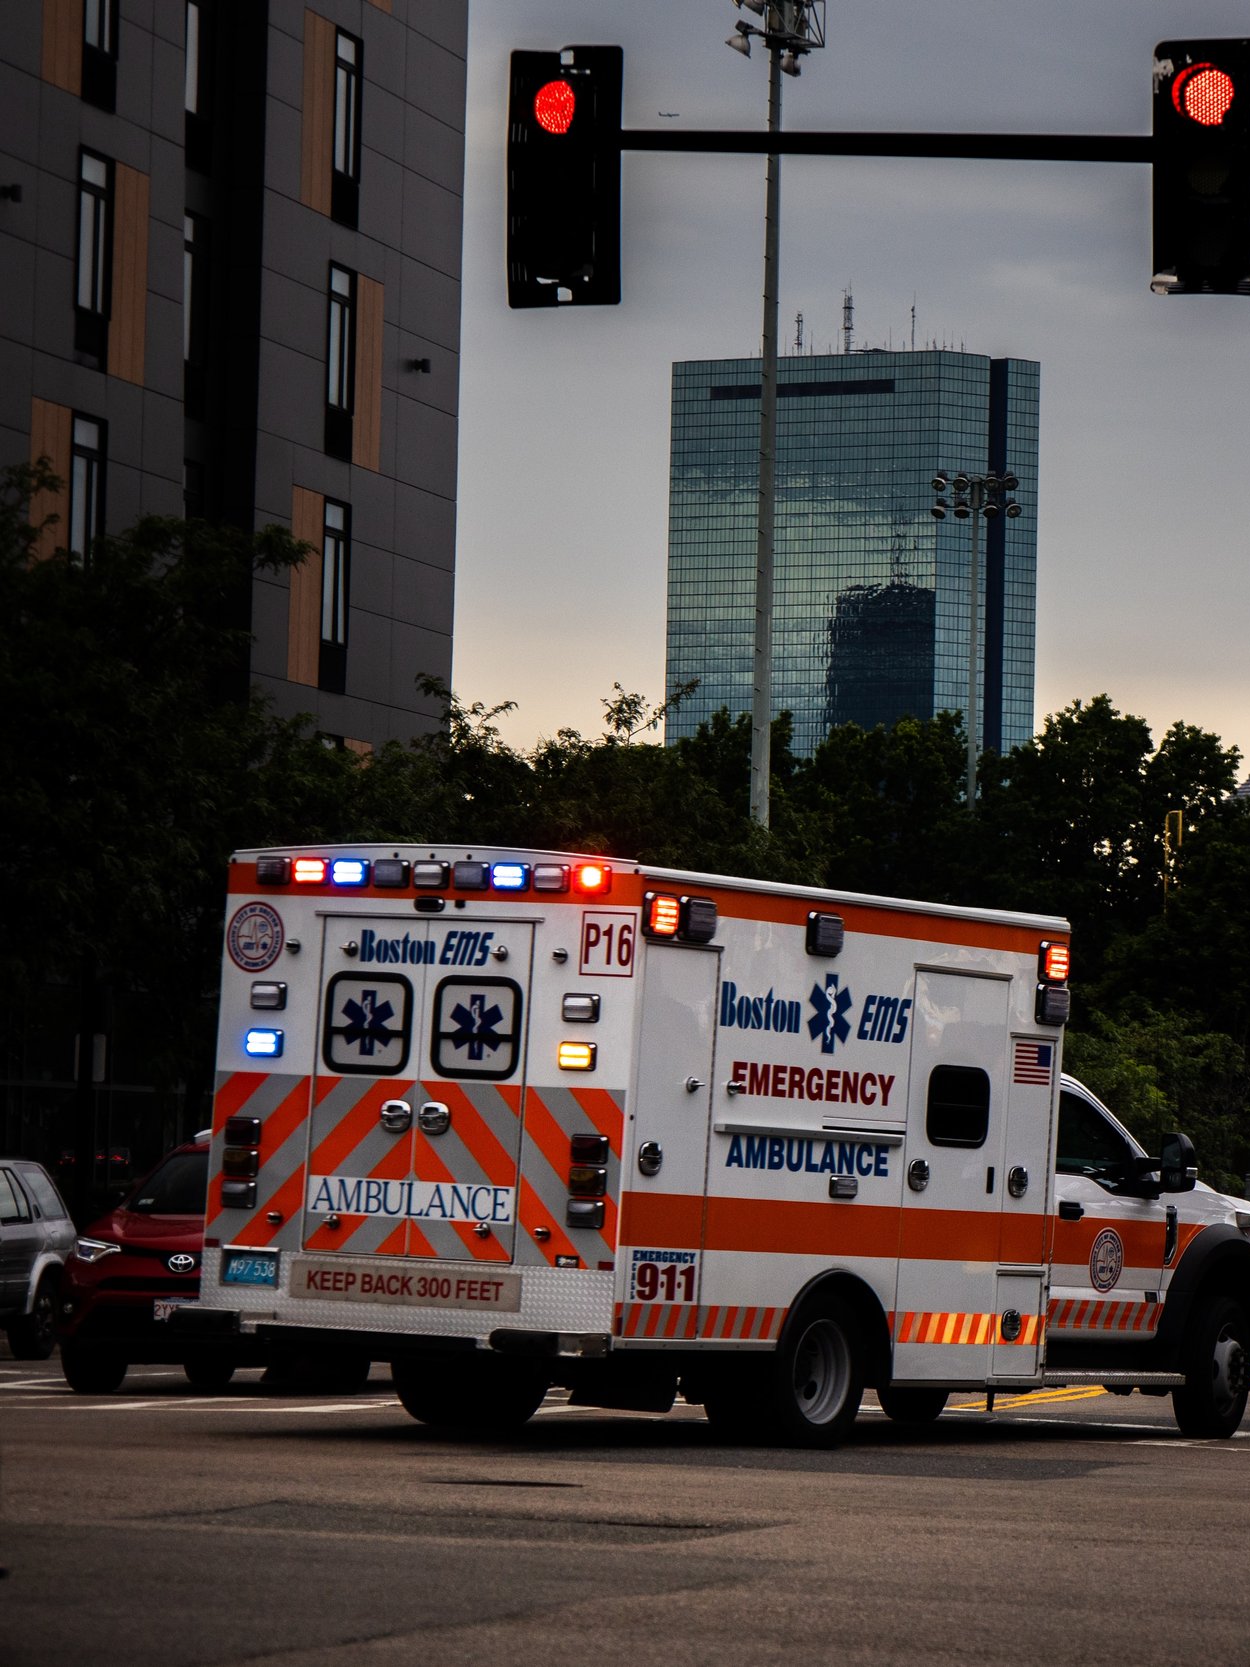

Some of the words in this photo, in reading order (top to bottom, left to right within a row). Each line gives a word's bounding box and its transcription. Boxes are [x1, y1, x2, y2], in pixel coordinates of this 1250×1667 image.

[359, 929, 437, 965] Boston
[440, 931, 490, 966] EMS
[584, 924, 632, 967] P16
[719, 980, 801, 1034] Boston
[857, 994, 912, 1043] EMS
[732, 1061, 895, 1106] EMERGENCY
[725, 1135, 889, 1177] AMBULANCE
[311, 1178, 511, 1222] AMBULANCE
[228, 1258, 253, 1275] M97
[253, 1261, 276, 1277] 538
[633, 1250, 696, 1263] EMERGENCY
[306, 1270, 357, 1292] KEEP
[360, 1272, 413, 1297] BACK
[417, 1278, 451, 1299] 300
[455, 1279, 504, 1302] FEET
